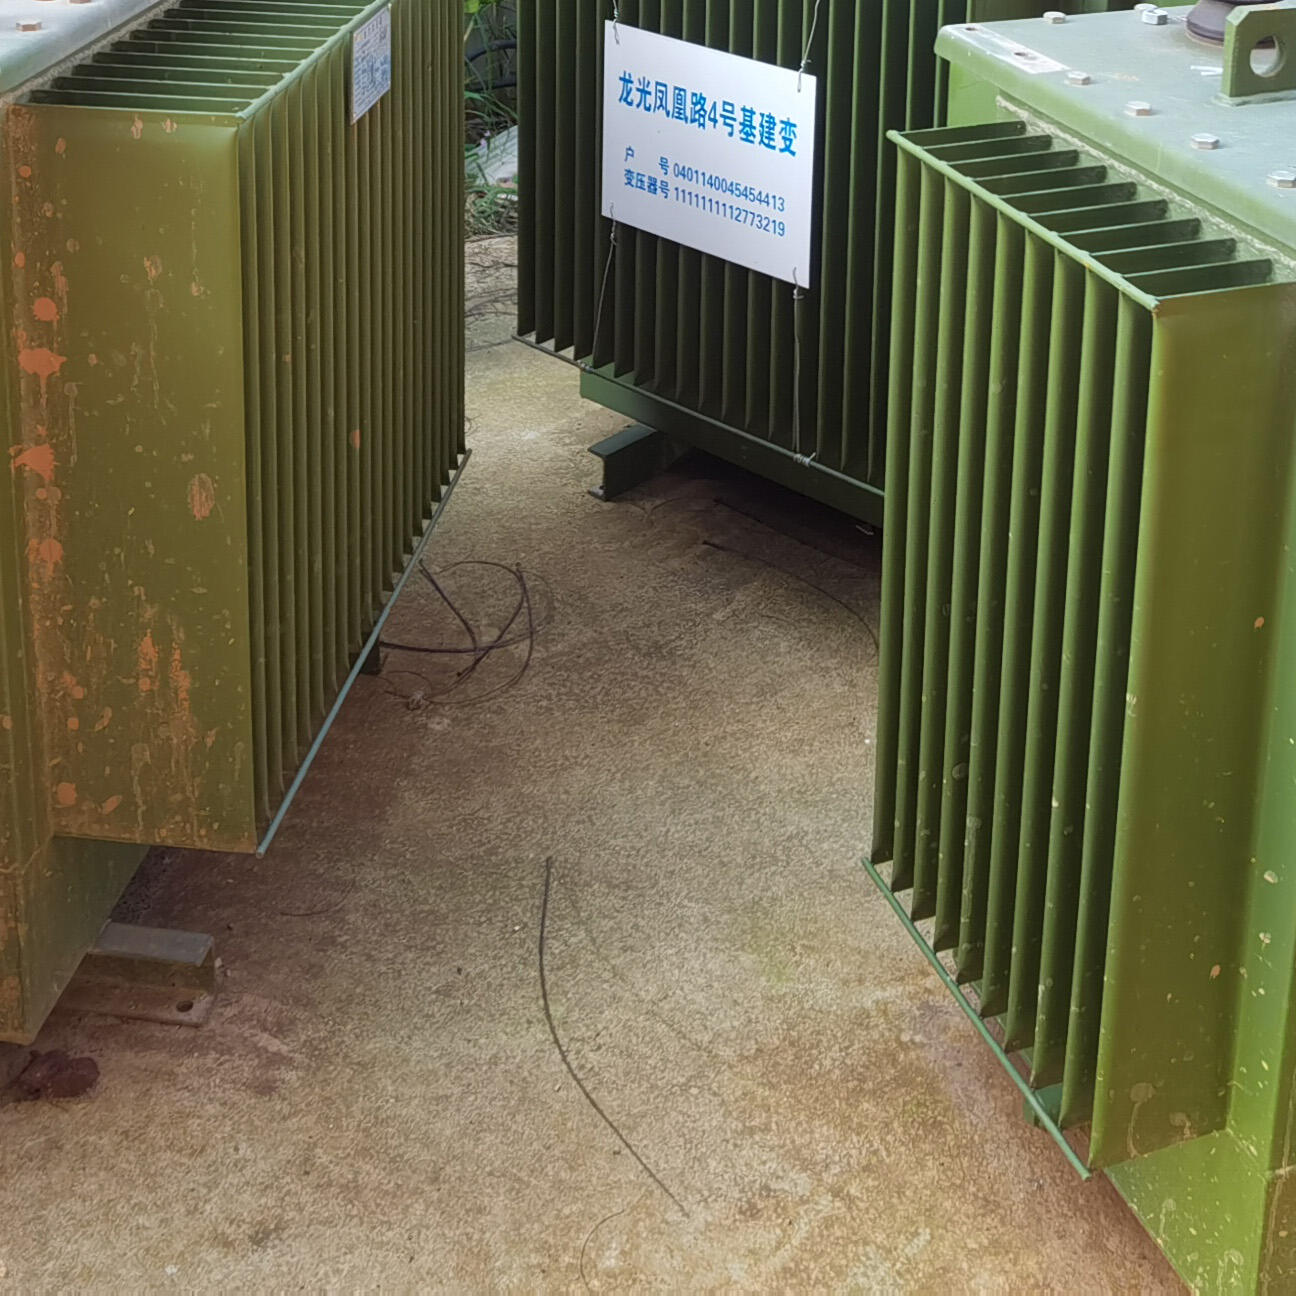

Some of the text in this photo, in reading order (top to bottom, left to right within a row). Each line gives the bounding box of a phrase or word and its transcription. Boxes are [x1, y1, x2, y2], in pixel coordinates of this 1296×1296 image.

[618, 70, 798, 157] 龙光凤凰路4号基建变
[623, 168, 786, 237] 变压器号 1111111112773219
[624, 146, 786, 212] 户号 0401140045454413
